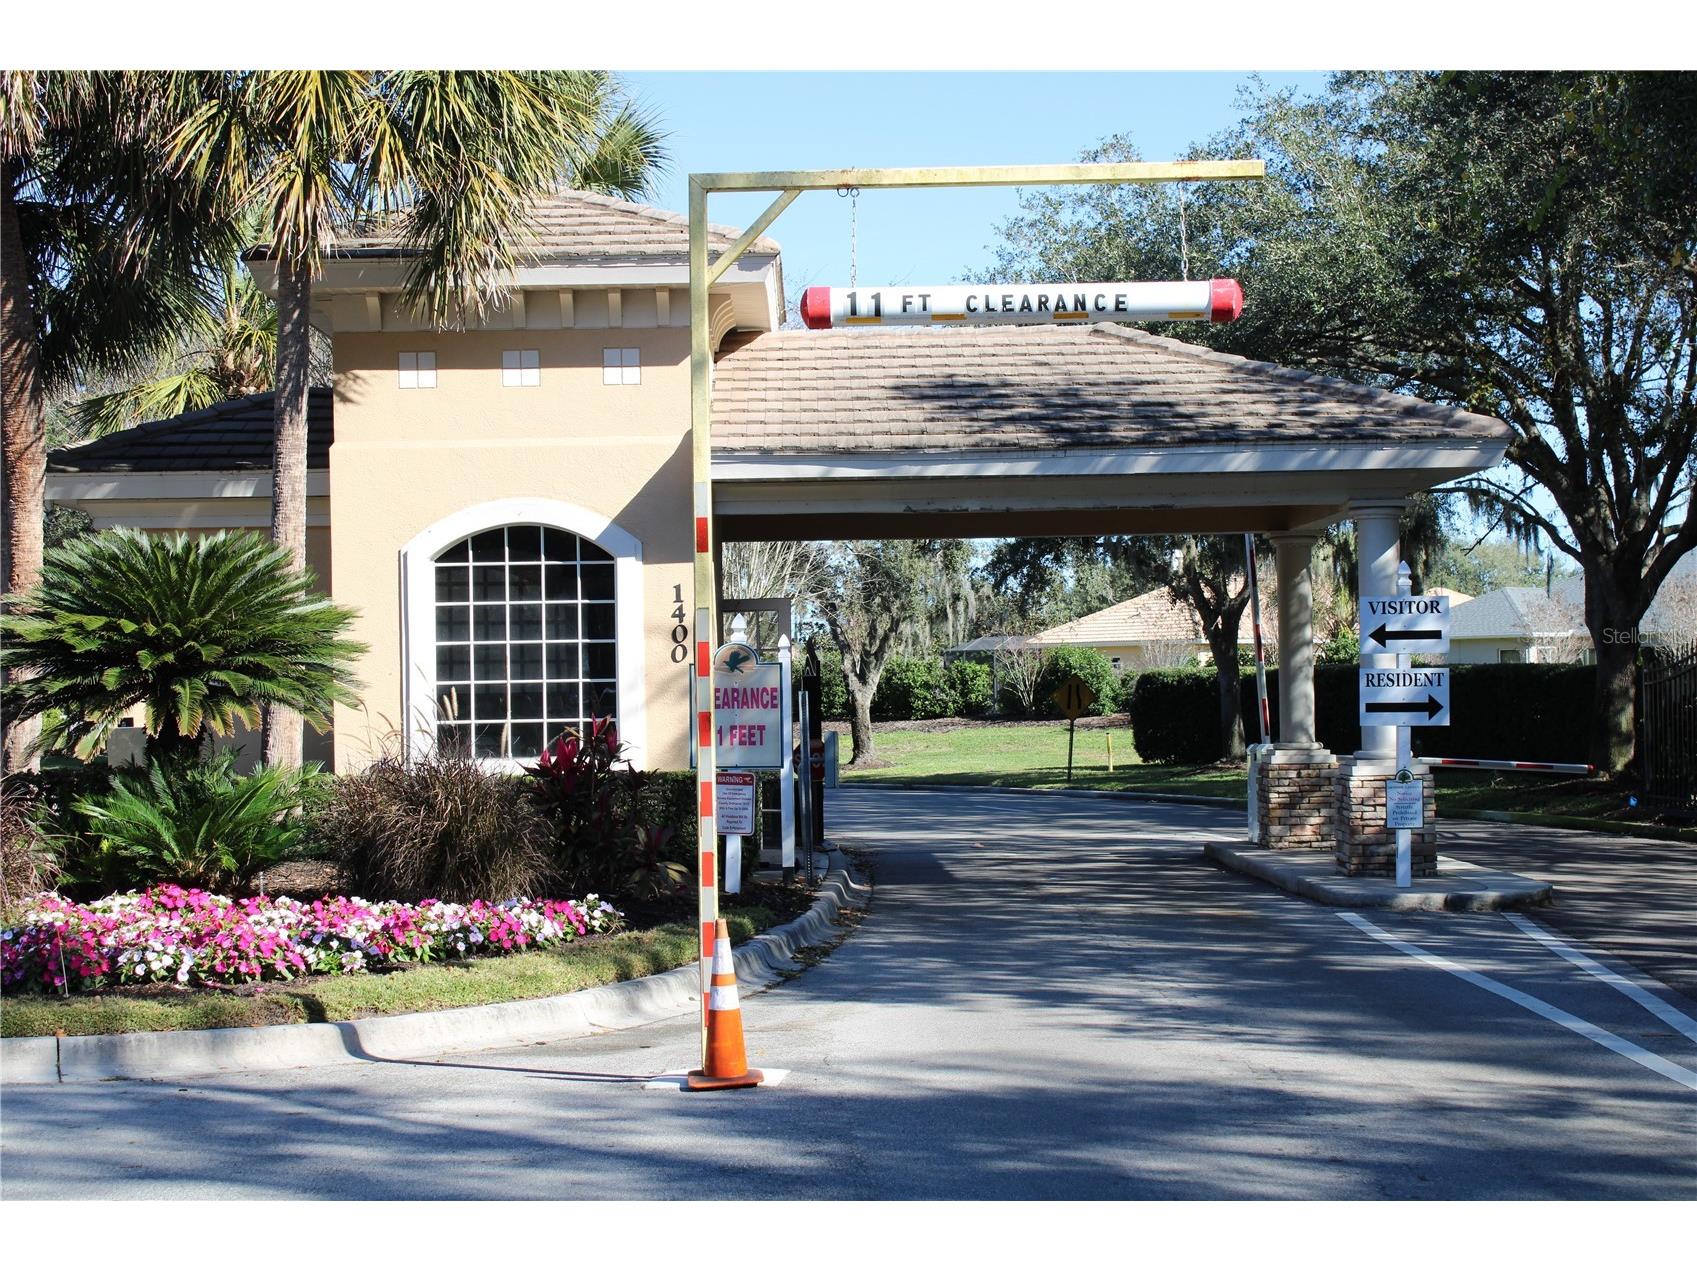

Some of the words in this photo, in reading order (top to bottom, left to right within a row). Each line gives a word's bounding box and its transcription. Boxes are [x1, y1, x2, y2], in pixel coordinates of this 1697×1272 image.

[847, 291, 881, 316] 11
[902, 294, 931, 313] FT
[965, 293, 1128, 313] CLEARANCE
[1368, 600, 1442, 615] VISITOR
[670, 583, 688, 663] 1400
[1365, 672, 1444, 688] RESIDENT
[714, 687, 778, 710] EARANCE
[729, 725, 766, 746] FEET
